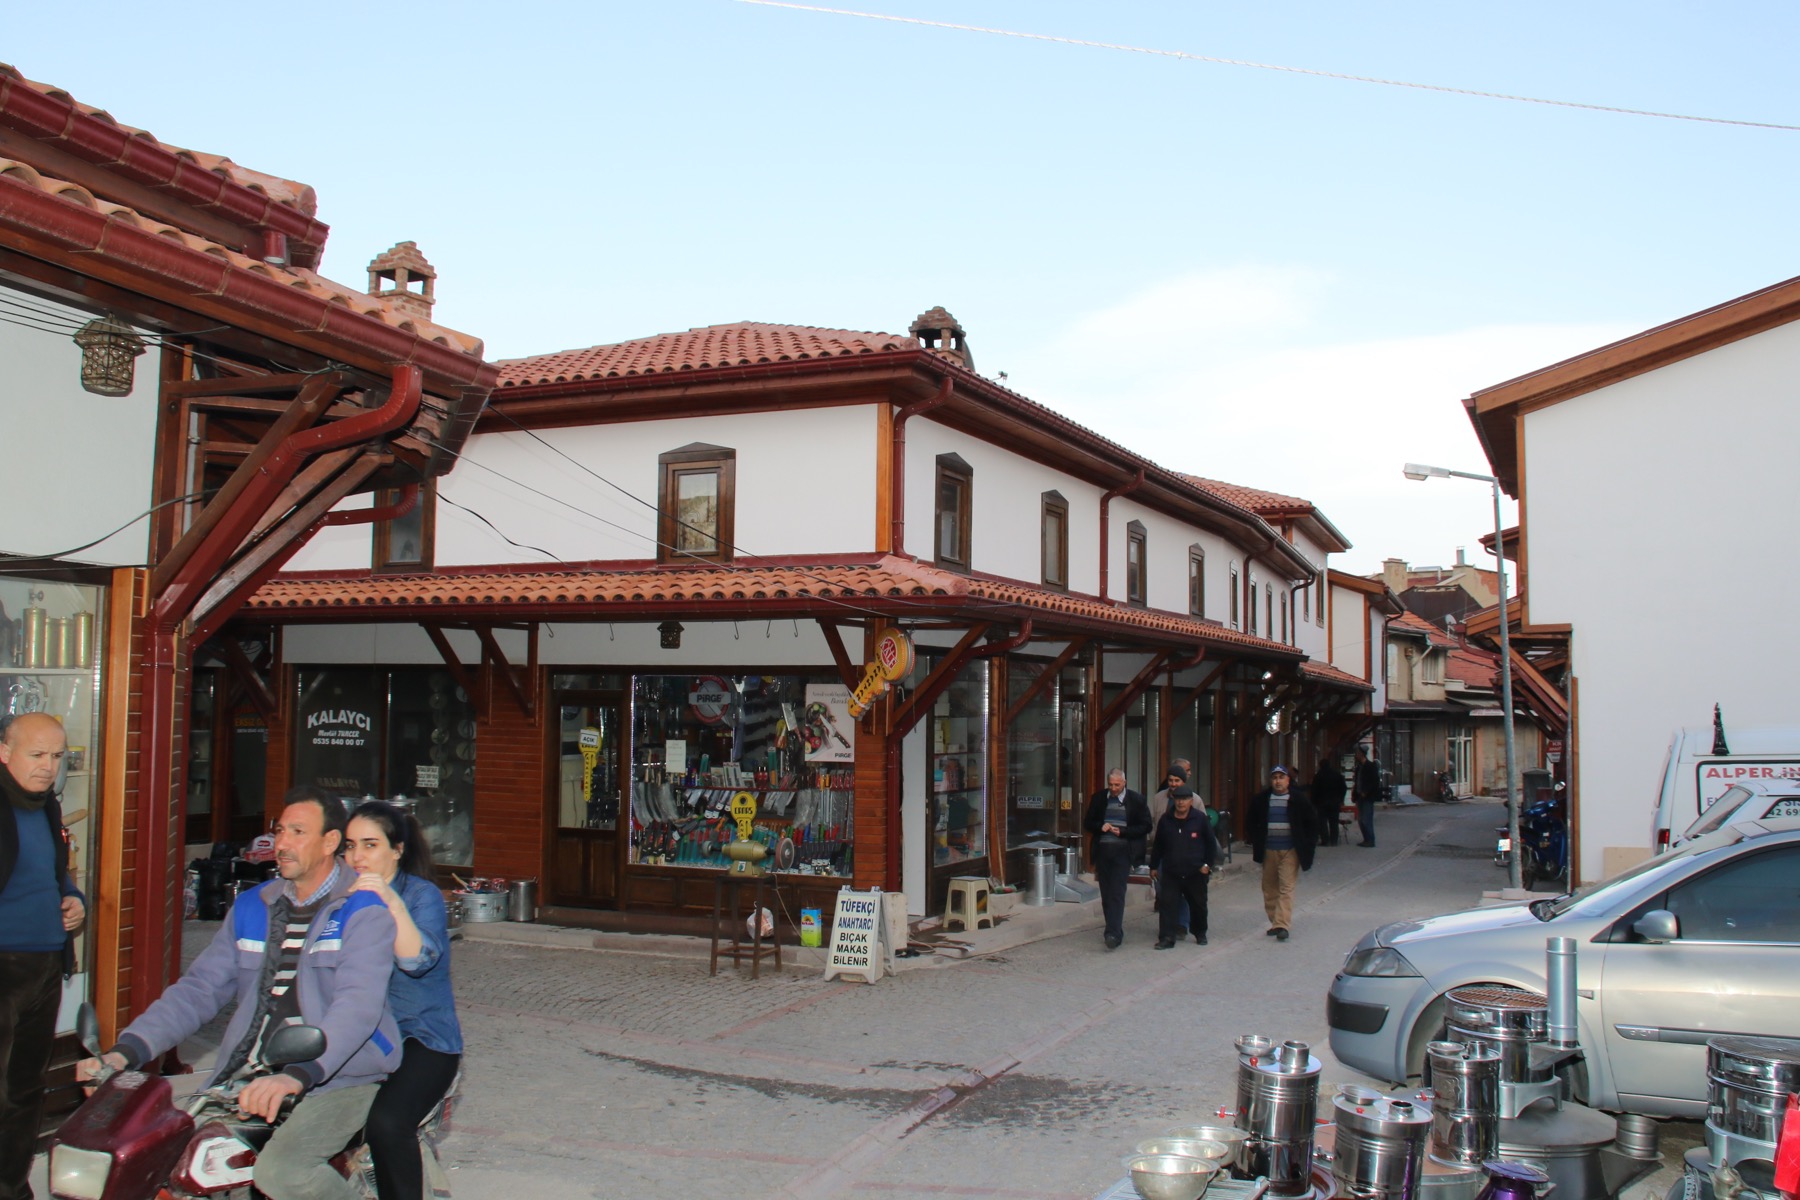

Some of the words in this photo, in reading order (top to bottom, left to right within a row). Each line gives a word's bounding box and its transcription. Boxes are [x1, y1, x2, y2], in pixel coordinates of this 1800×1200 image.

[880, 640, 898, 670] KALE
[307, 709, 371, 732] KALAYCI
[1706, 767, 1774, 778] ALPER
[841, 899, 875, 916] TÜFEKÇİ
[838, 917, 873, 931] ANAHTARCI
[840, 932, 868, 944] BIÇAK
[836, 944, 868, 955] MAKAS
